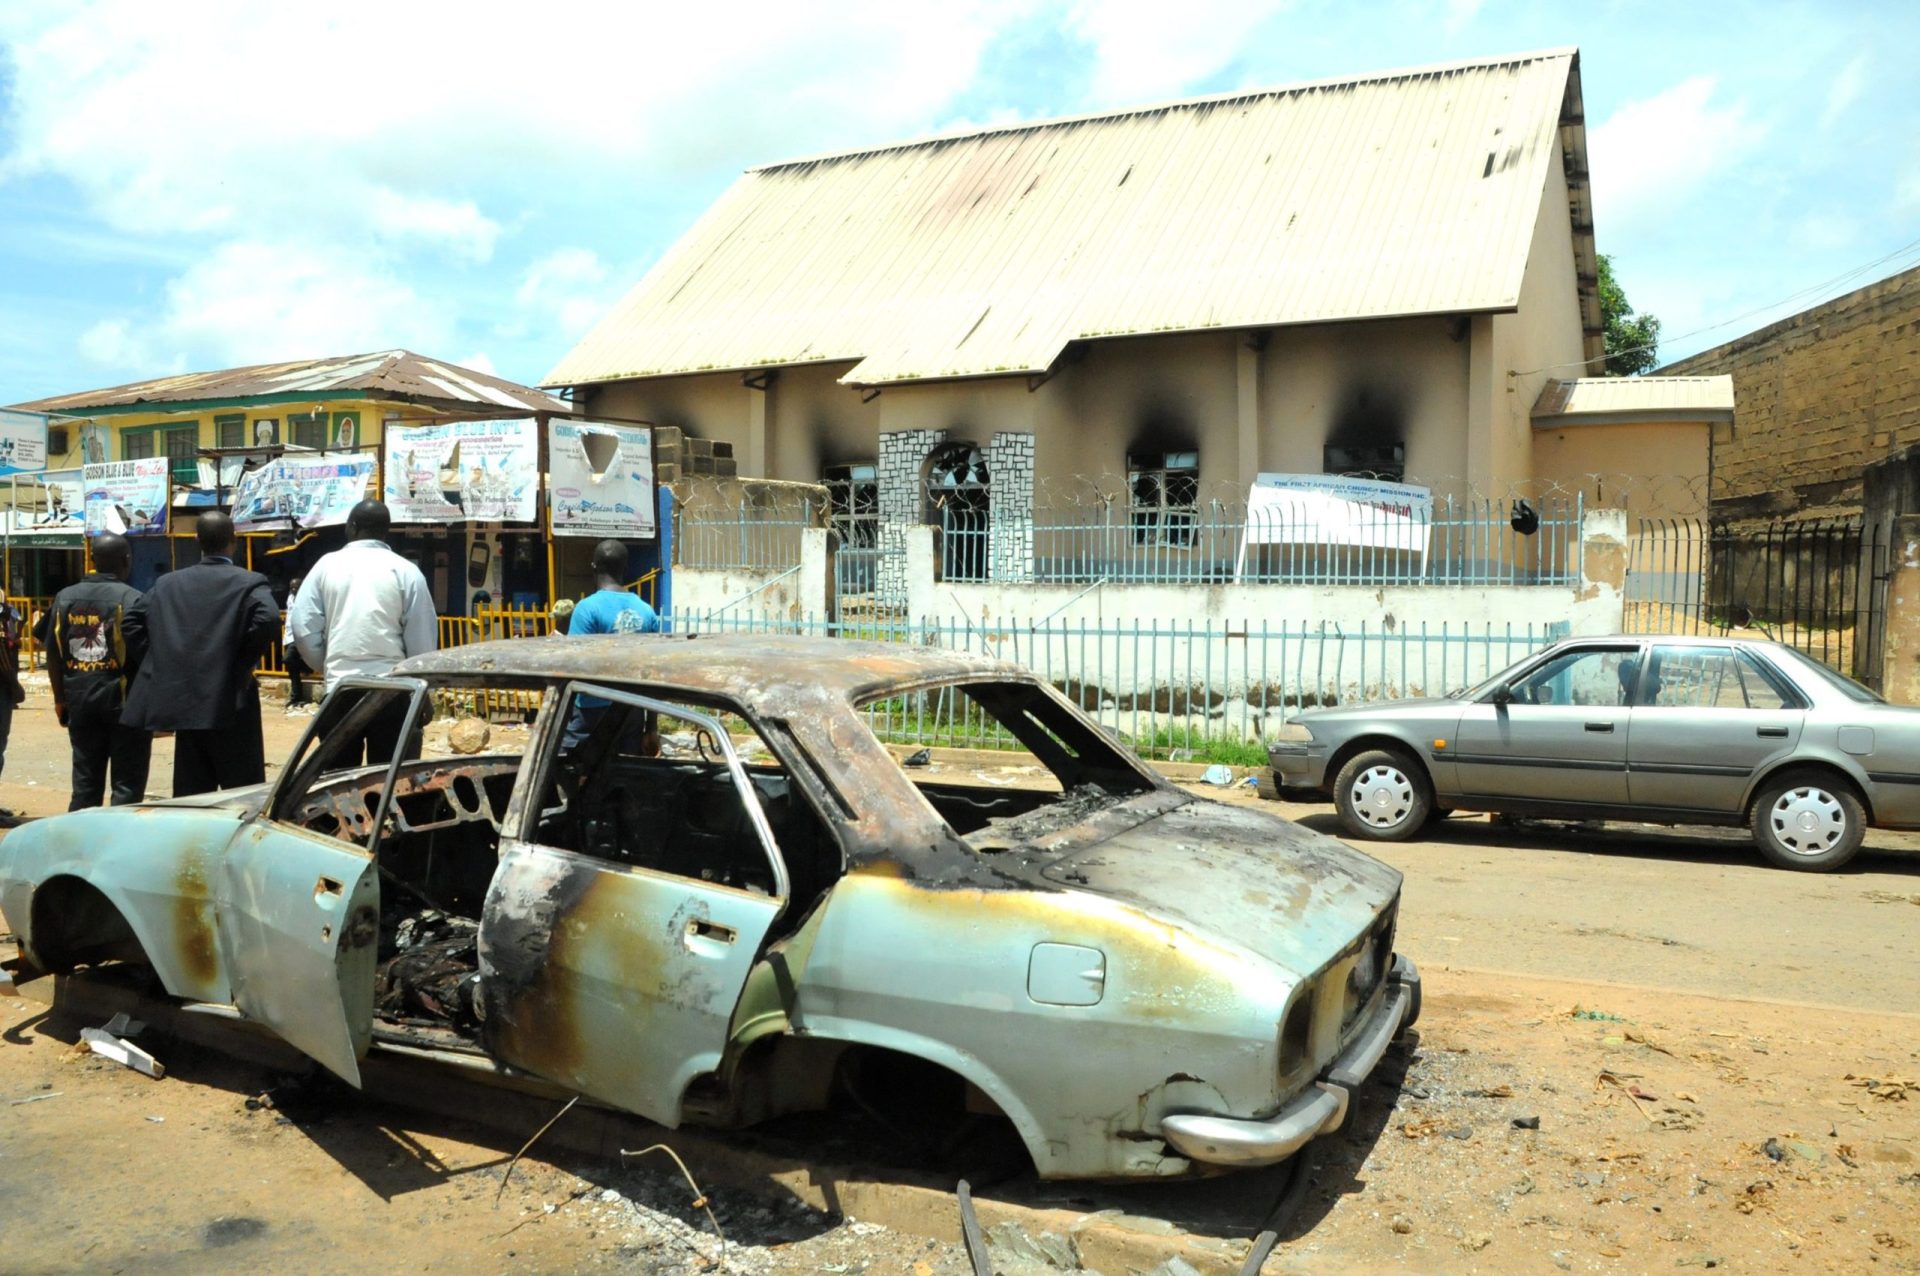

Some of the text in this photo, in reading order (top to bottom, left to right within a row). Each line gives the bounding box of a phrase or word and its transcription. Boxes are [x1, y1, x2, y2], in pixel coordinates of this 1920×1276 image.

[86, 464, 105, 480] GODSON
[106, 464, 117, 478] BLUE
[122, 462, 135, 477] BLUE
[1347, 485, 1378, 493] CHURCH
[1380, 488, 1410, 496] MISSION
